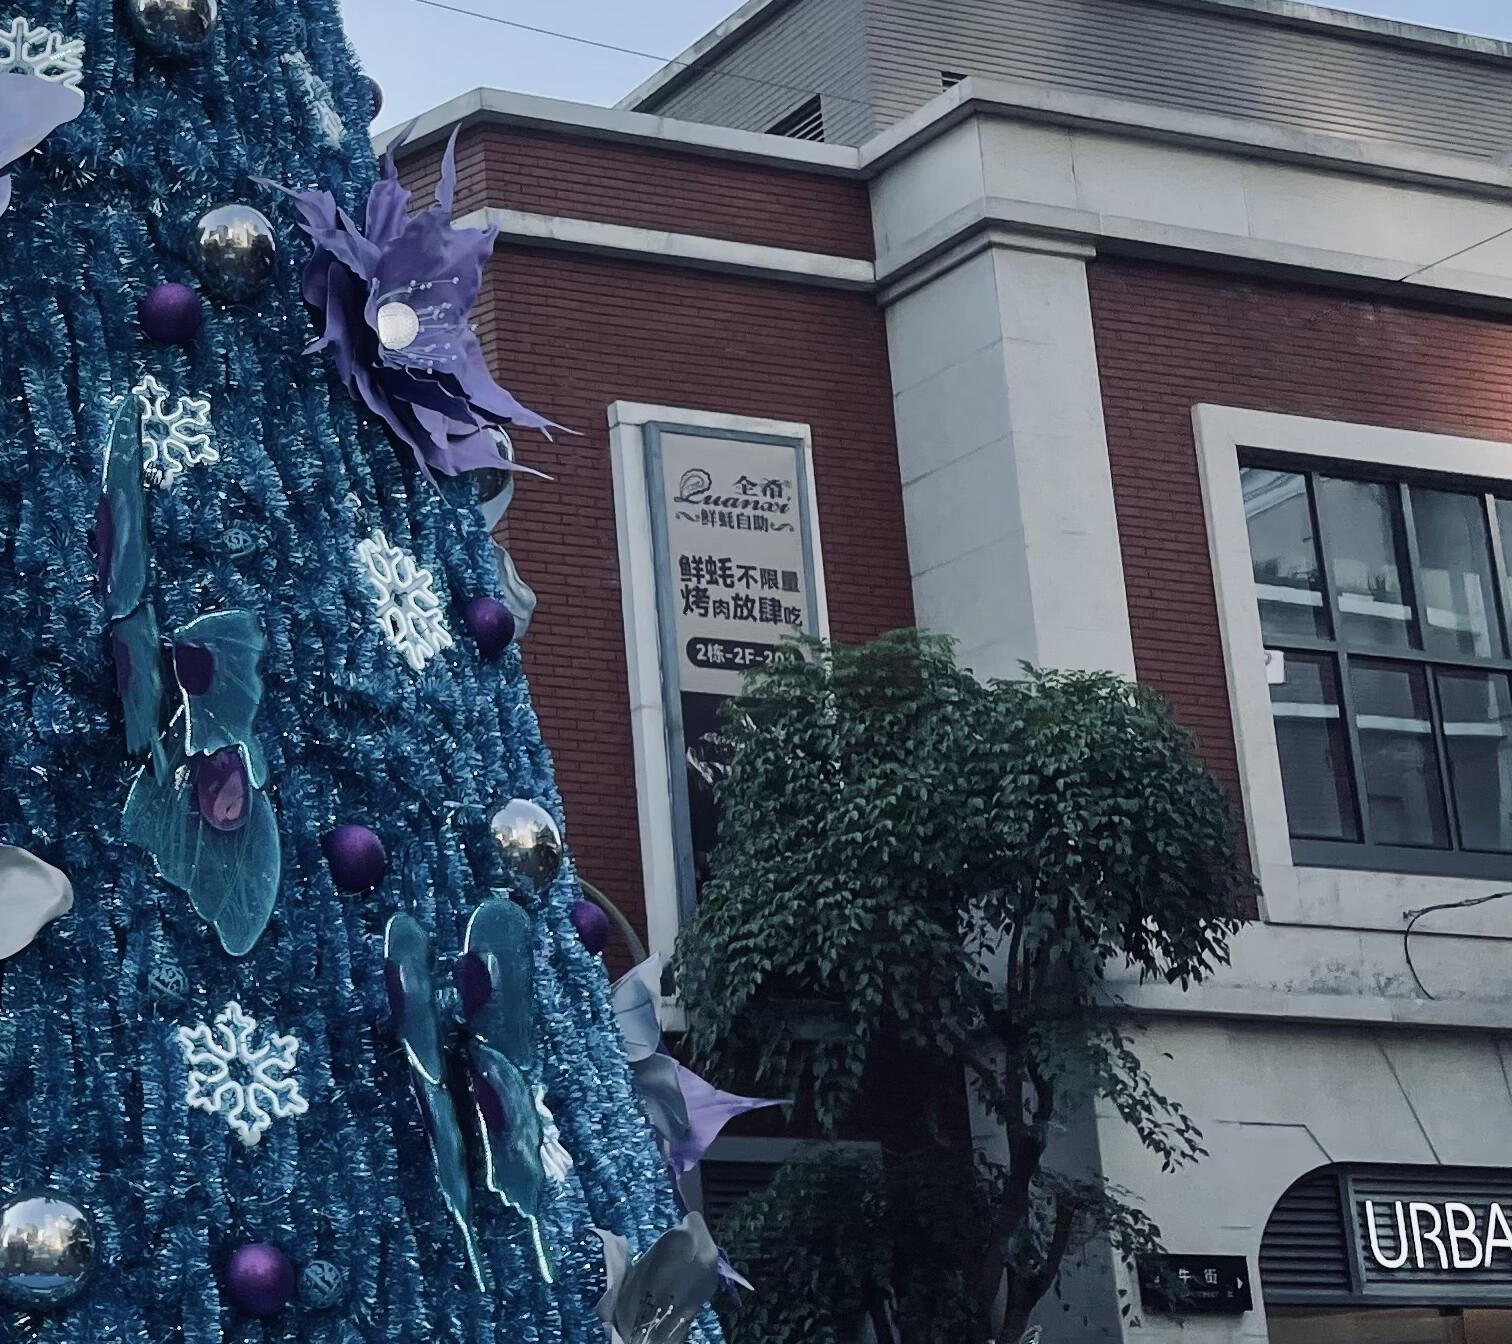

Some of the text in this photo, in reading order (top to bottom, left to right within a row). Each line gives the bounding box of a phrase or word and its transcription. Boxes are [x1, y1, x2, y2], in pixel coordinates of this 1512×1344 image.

[700, 508, 770, 533] 鲜蚝自助
[678, 554, 801, 594] 鲜蚝不限量
[680, 583, 804, 627] 烤肉放肆吃
